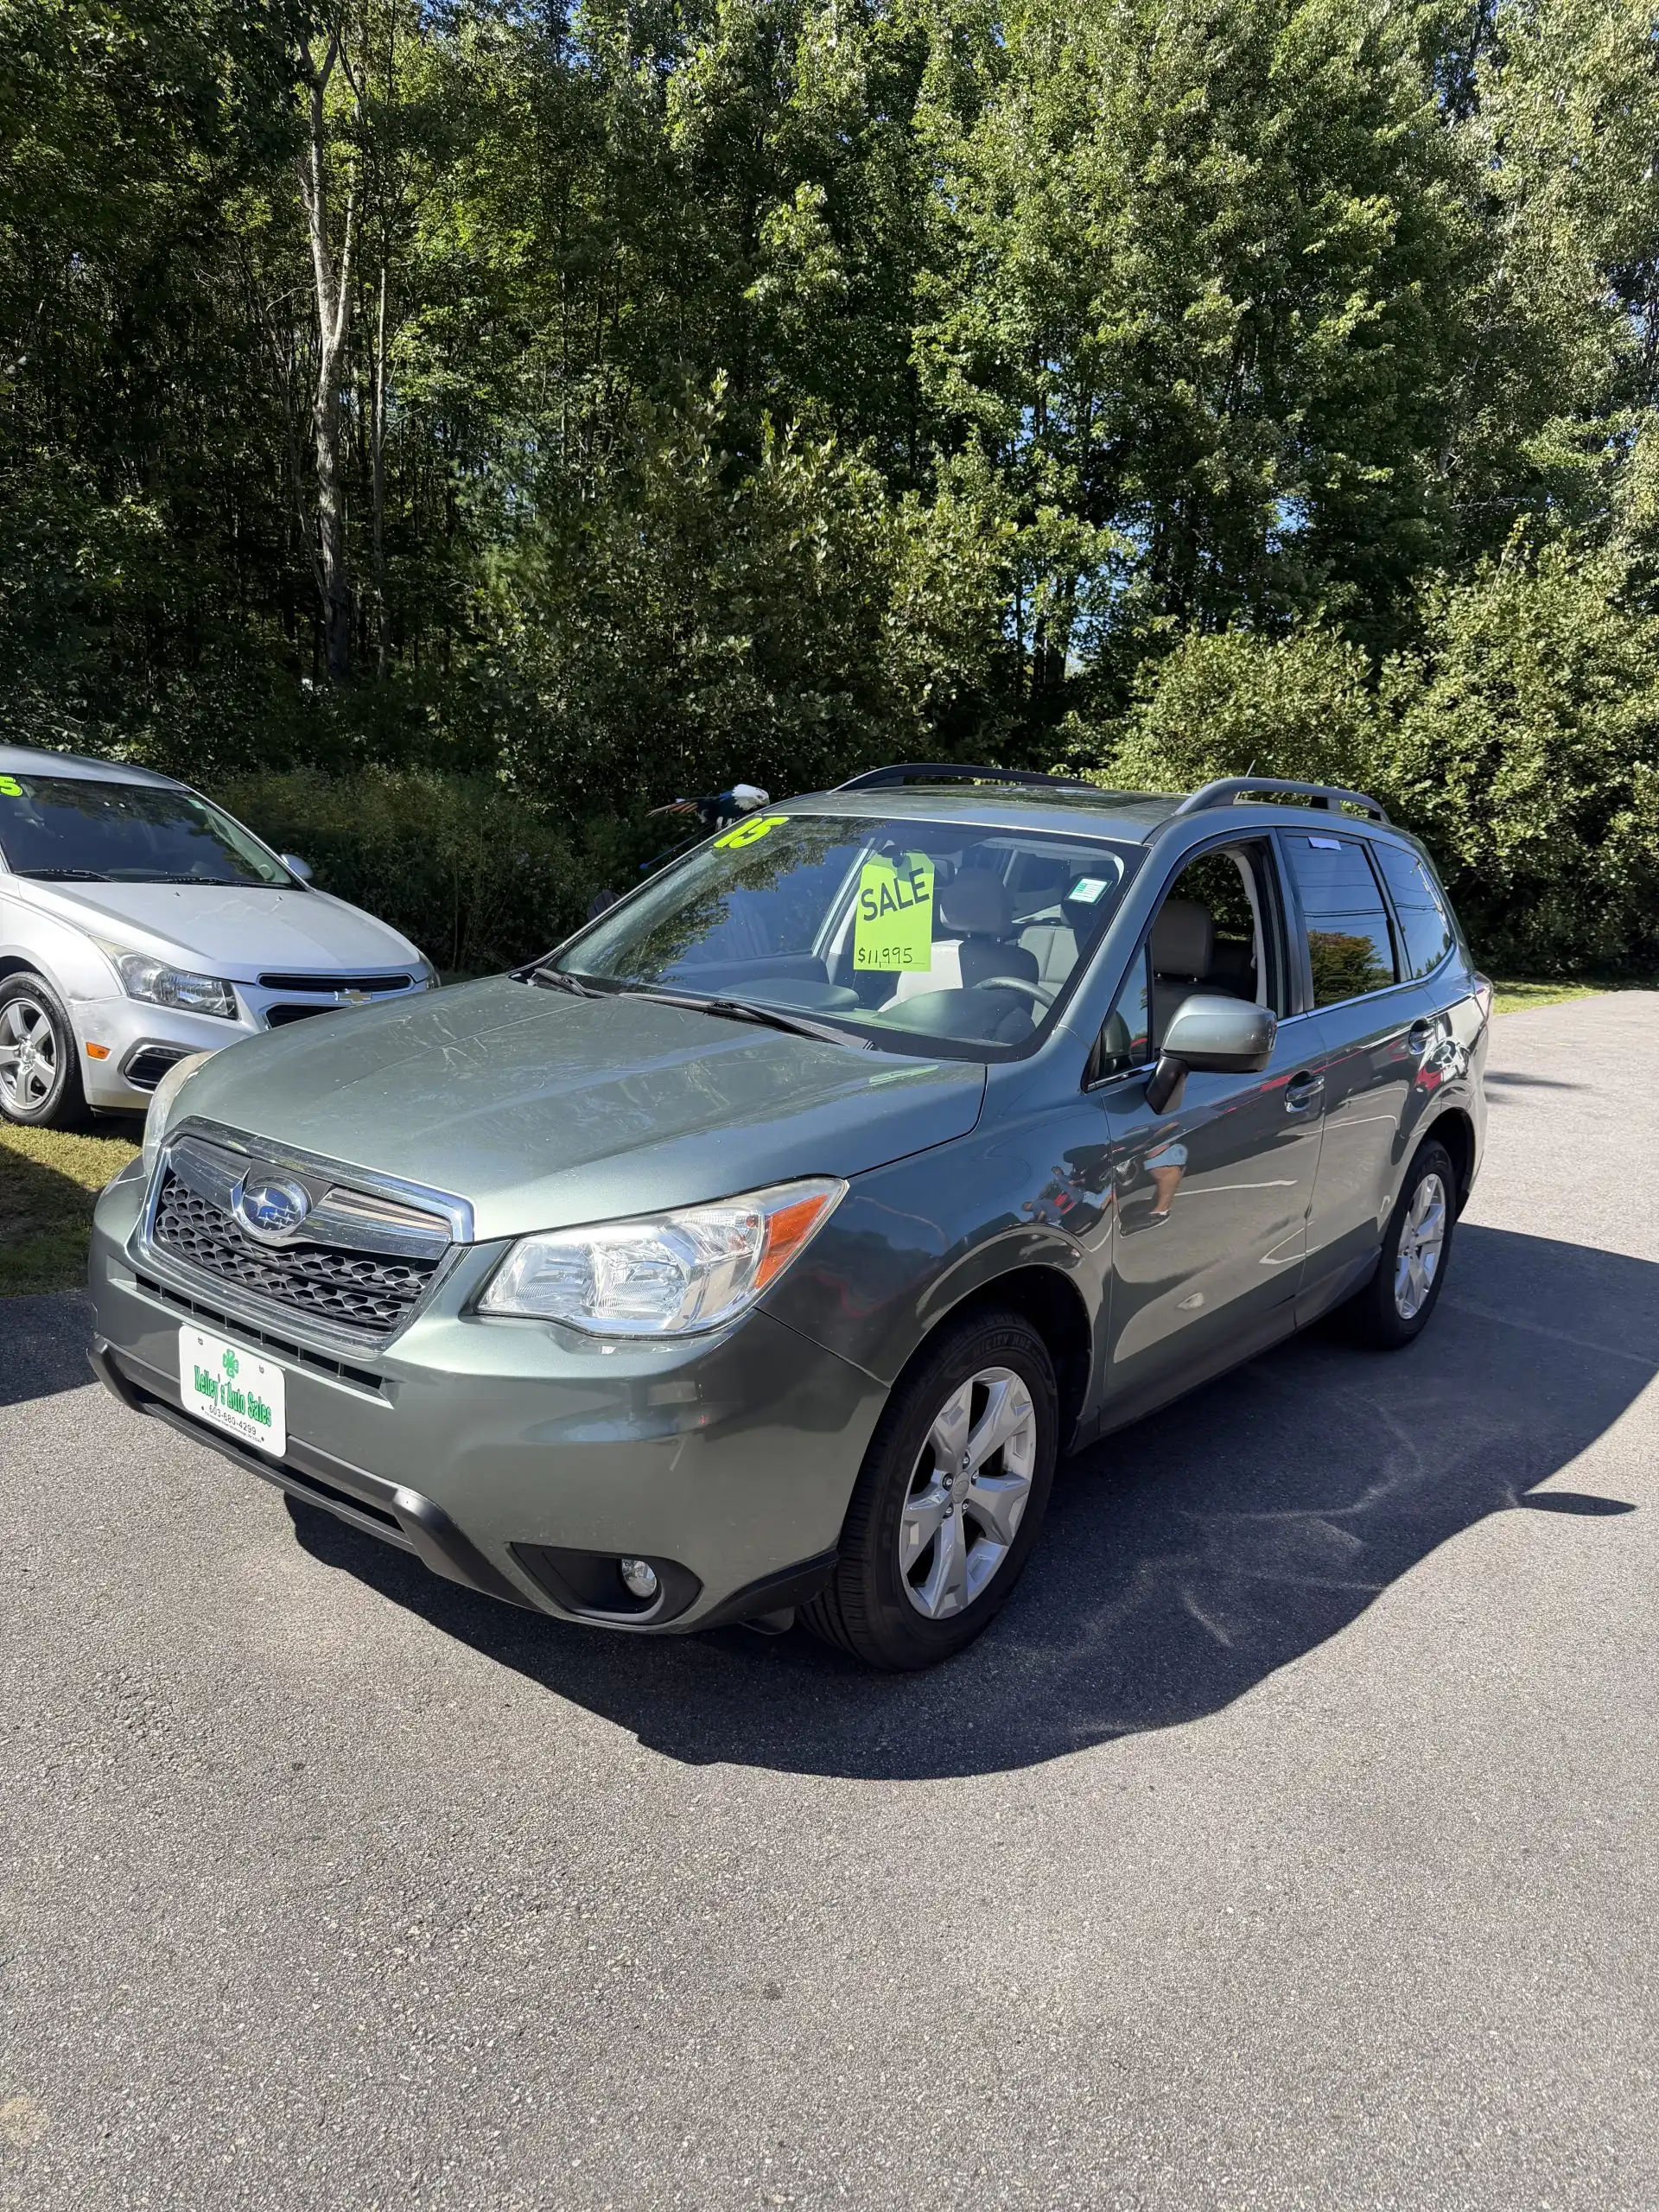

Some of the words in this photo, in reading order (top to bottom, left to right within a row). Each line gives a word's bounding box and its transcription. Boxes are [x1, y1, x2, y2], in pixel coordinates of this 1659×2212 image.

[714, 817, 790, 849] 15
[861, 868, 931, 921] SALE
[858, 947, 913, 969] $11,995
[194, 1365, 226, 1406] Kelley's
[226, 1381, 245, 1415] Auto
[248, 1391, 272, 1427] Sales
[209, 1404, 257, 1435] 603-680-4299
